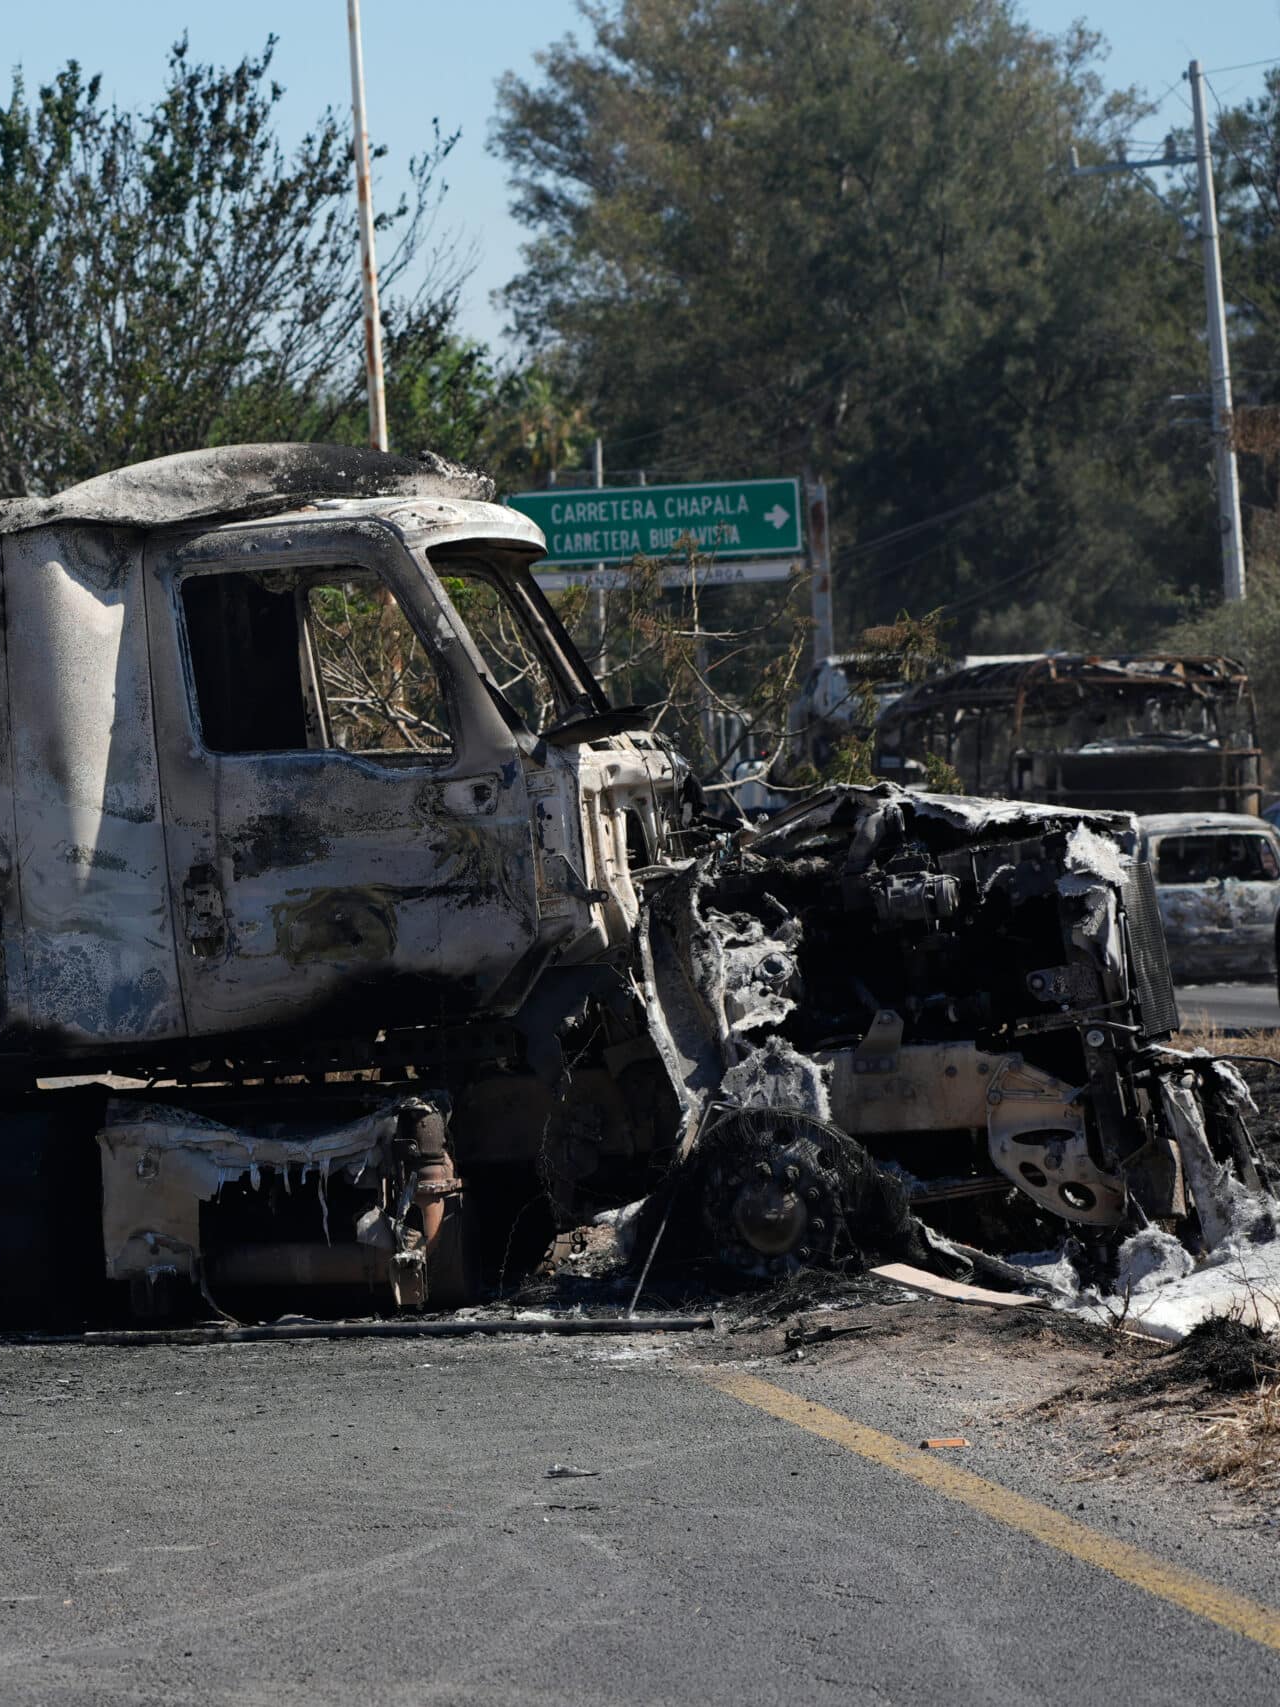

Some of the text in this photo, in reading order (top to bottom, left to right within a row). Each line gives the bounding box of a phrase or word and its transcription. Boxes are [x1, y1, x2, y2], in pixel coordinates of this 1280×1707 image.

[551, 494, 749, 524] CARRETERA CHAPALA
[553, 529, 640, 553] CARRETERA
